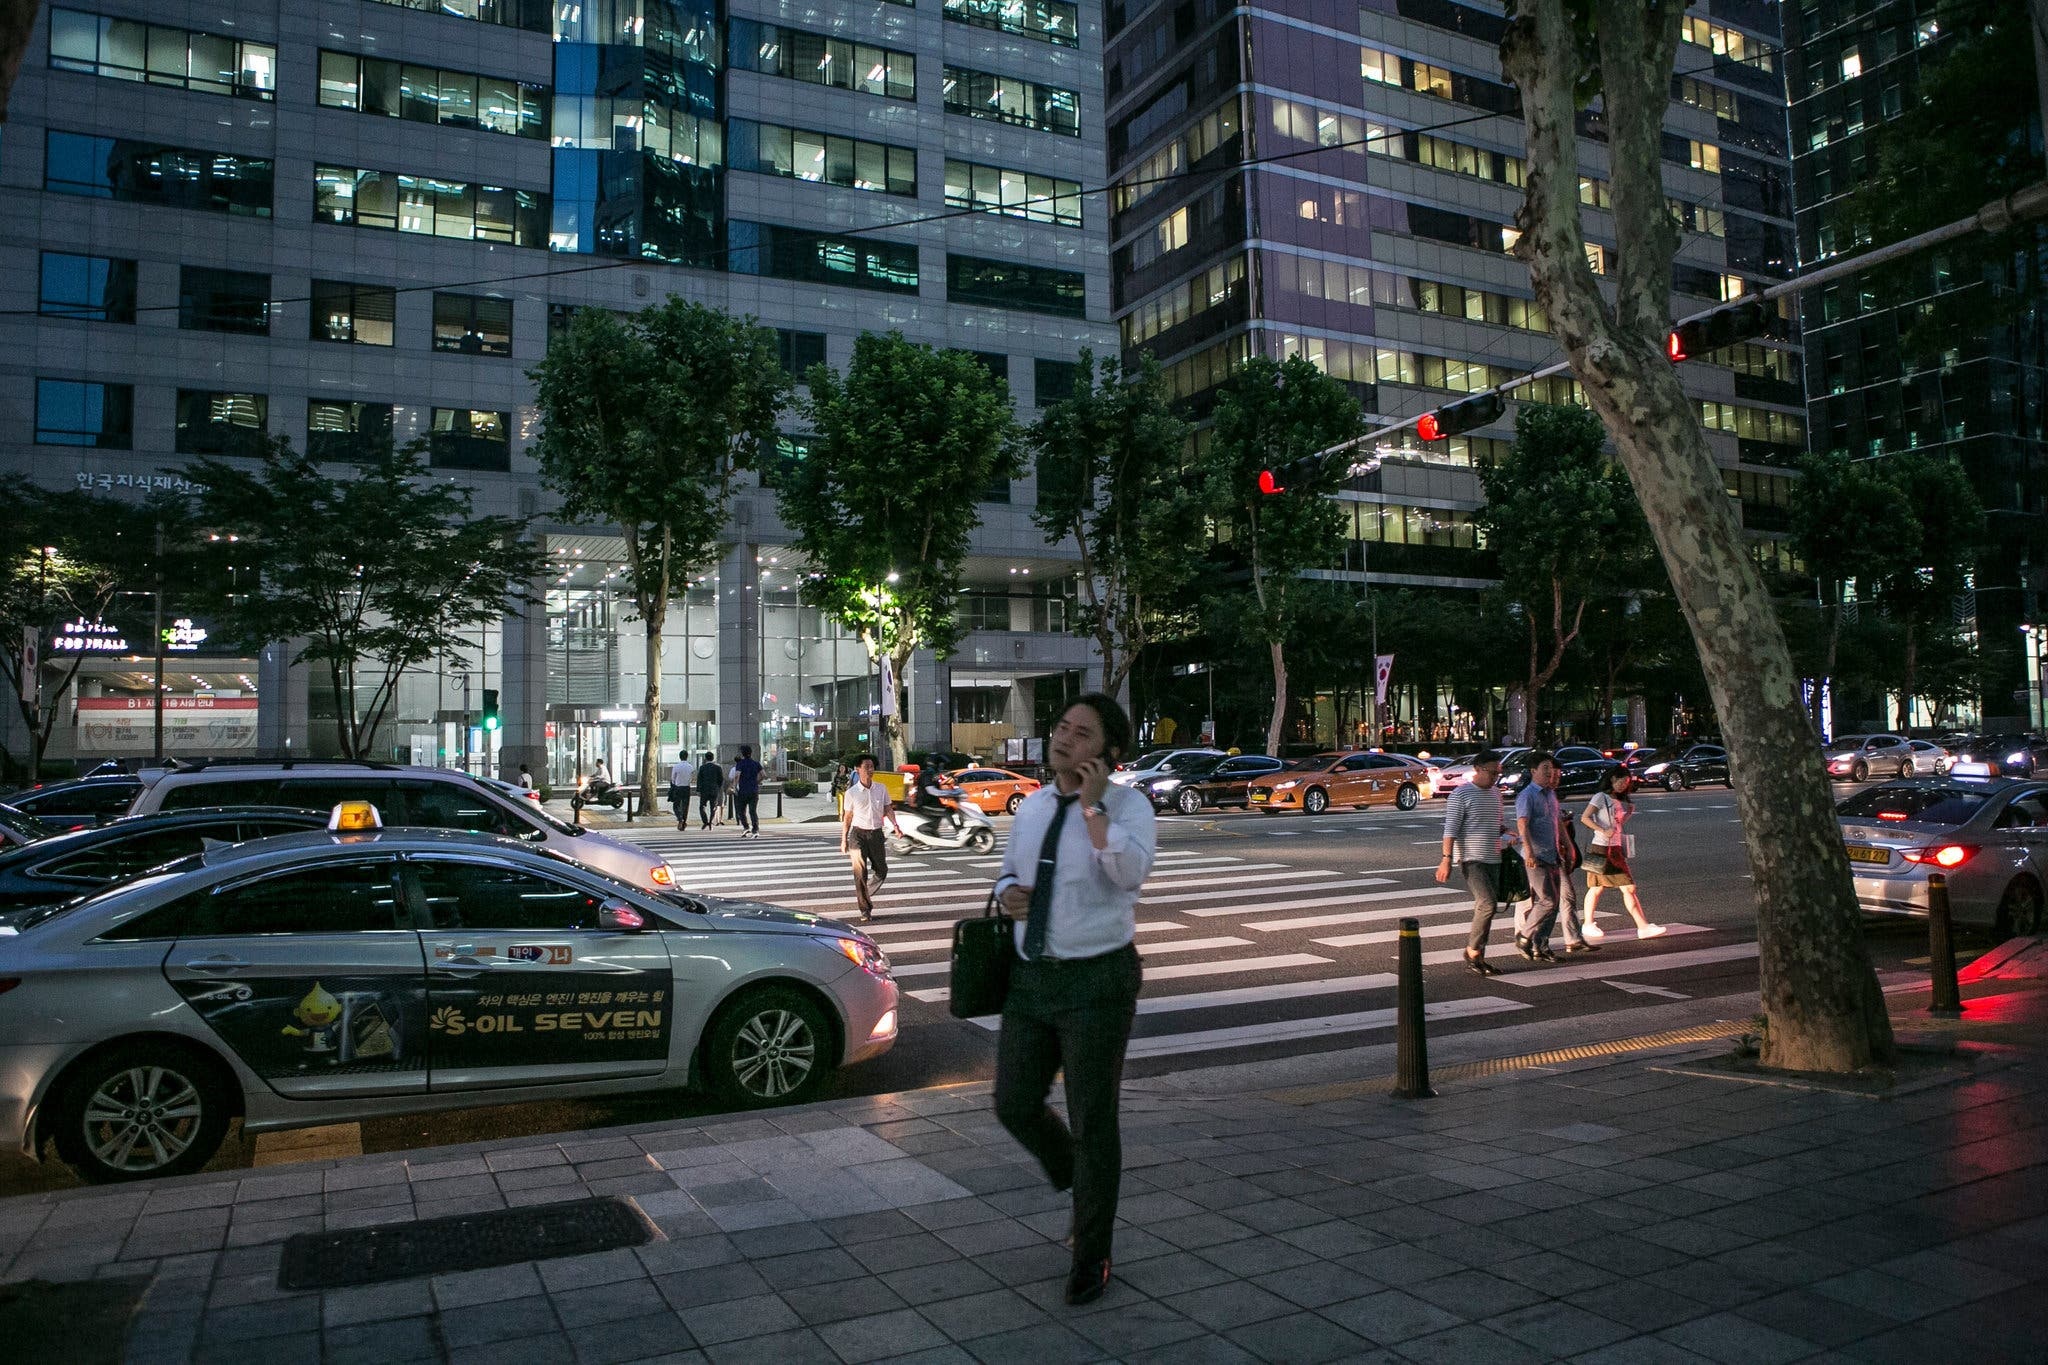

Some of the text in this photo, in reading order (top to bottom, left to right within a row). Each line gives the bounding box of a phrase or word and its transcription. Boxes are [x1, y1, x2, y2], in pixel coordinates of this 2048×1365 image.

[76, 472, 211, 495] 한국지식재산
[128, 699, 141, 708] B1
[554, 948, 569, 961] 나
[478, 995, 501, 1007] 차의
[545, 993, 575, 1005] 엔진!
[578, 992, 612, 1004] 엔진을
[445, 1010, 662, 1035] S-OIL SEVEN
